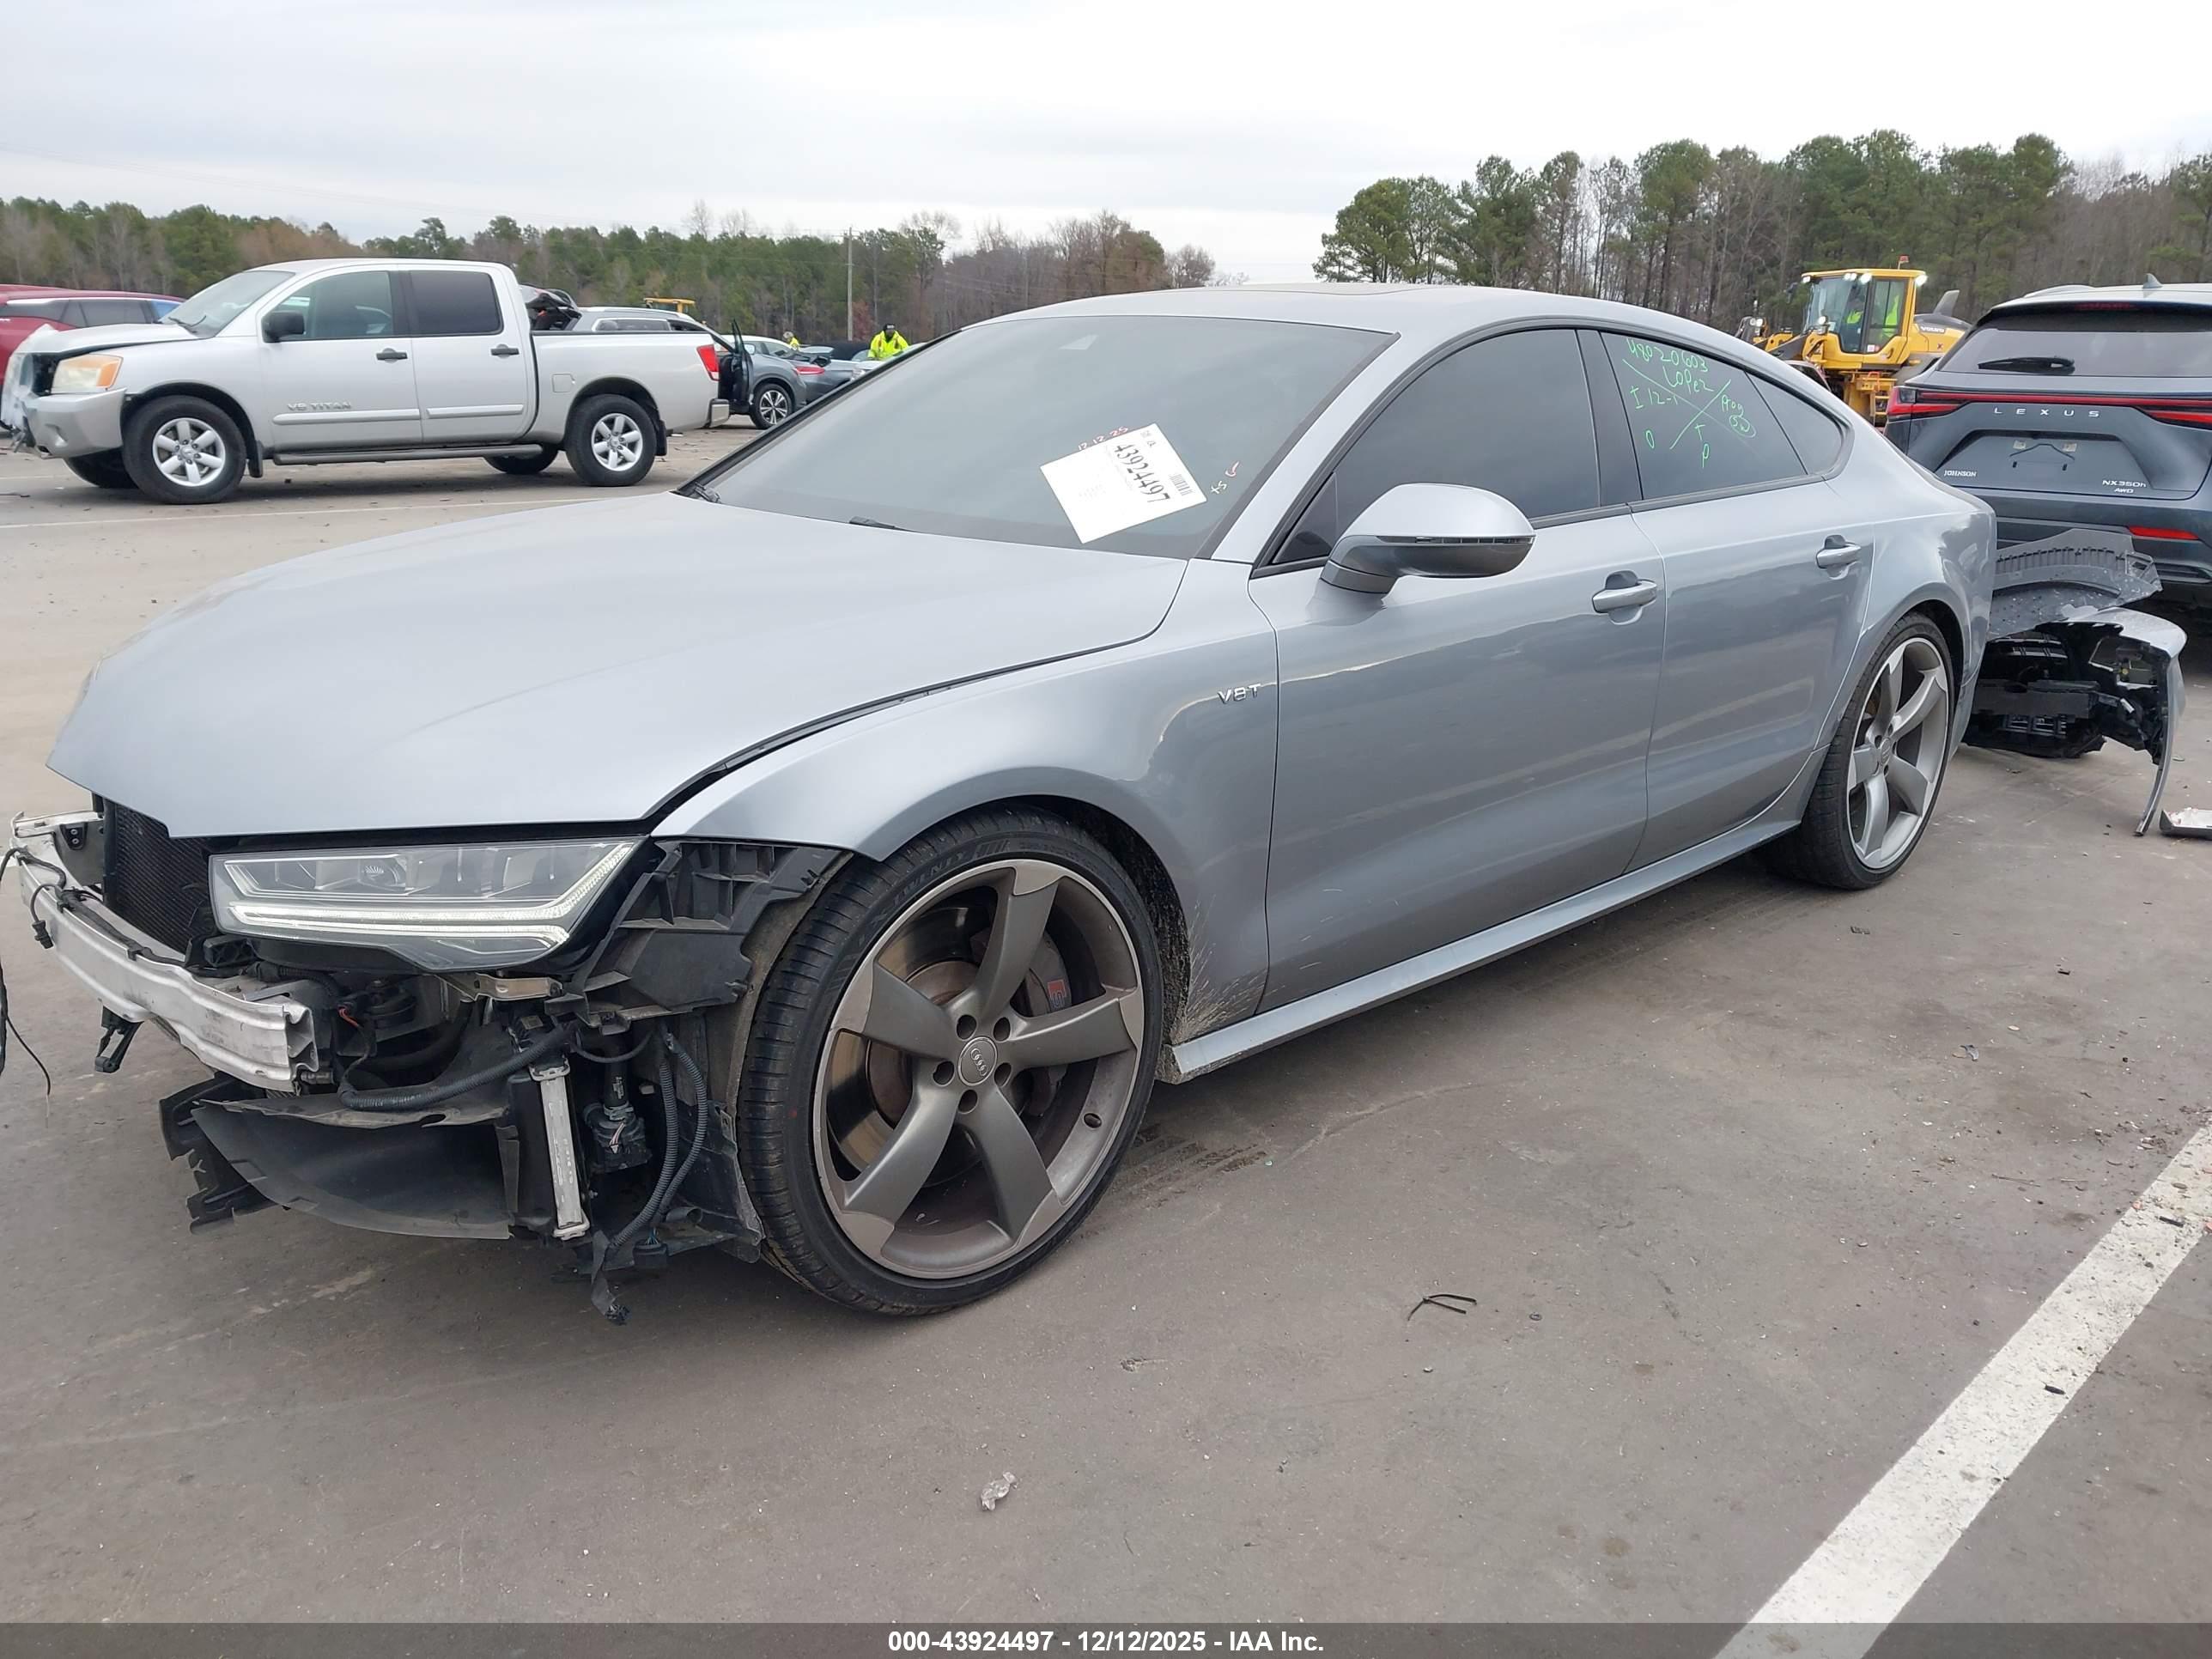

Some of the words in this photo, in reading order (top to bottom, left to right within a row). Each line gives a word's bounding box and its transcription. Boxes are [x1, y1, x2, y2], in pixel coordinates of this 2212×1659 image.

[310, 401, 352, 410] TITAN
[1994, 407, 2101, 417] LEXUS
[1114, 444, 1170, 503] 43924497
